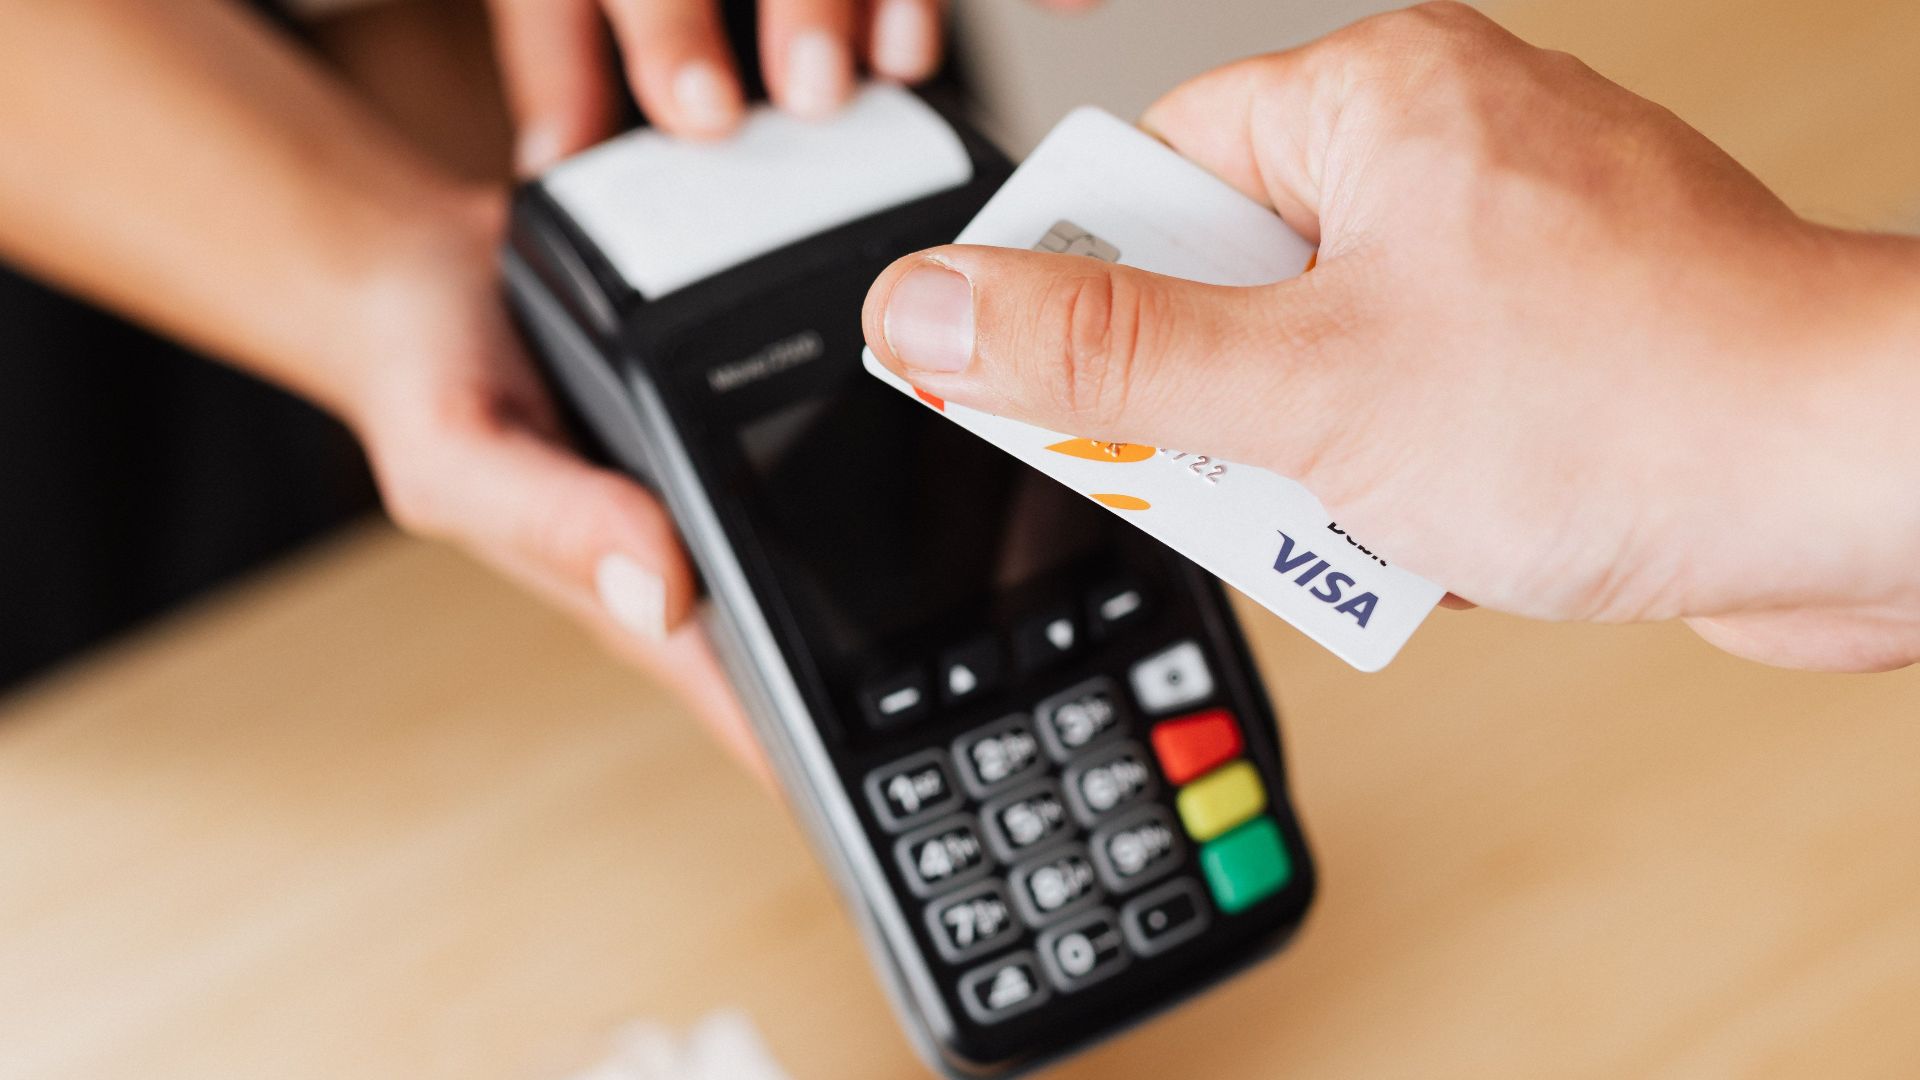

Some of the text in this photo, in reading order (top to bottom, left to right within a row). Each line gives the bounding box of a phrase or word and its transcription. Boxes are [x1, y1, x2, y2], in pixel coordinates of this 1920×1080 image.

[1273, 529, 1379, 629] VISA
[888, 774, 920, 813] 1
[944, 903, 975, 946] 7
